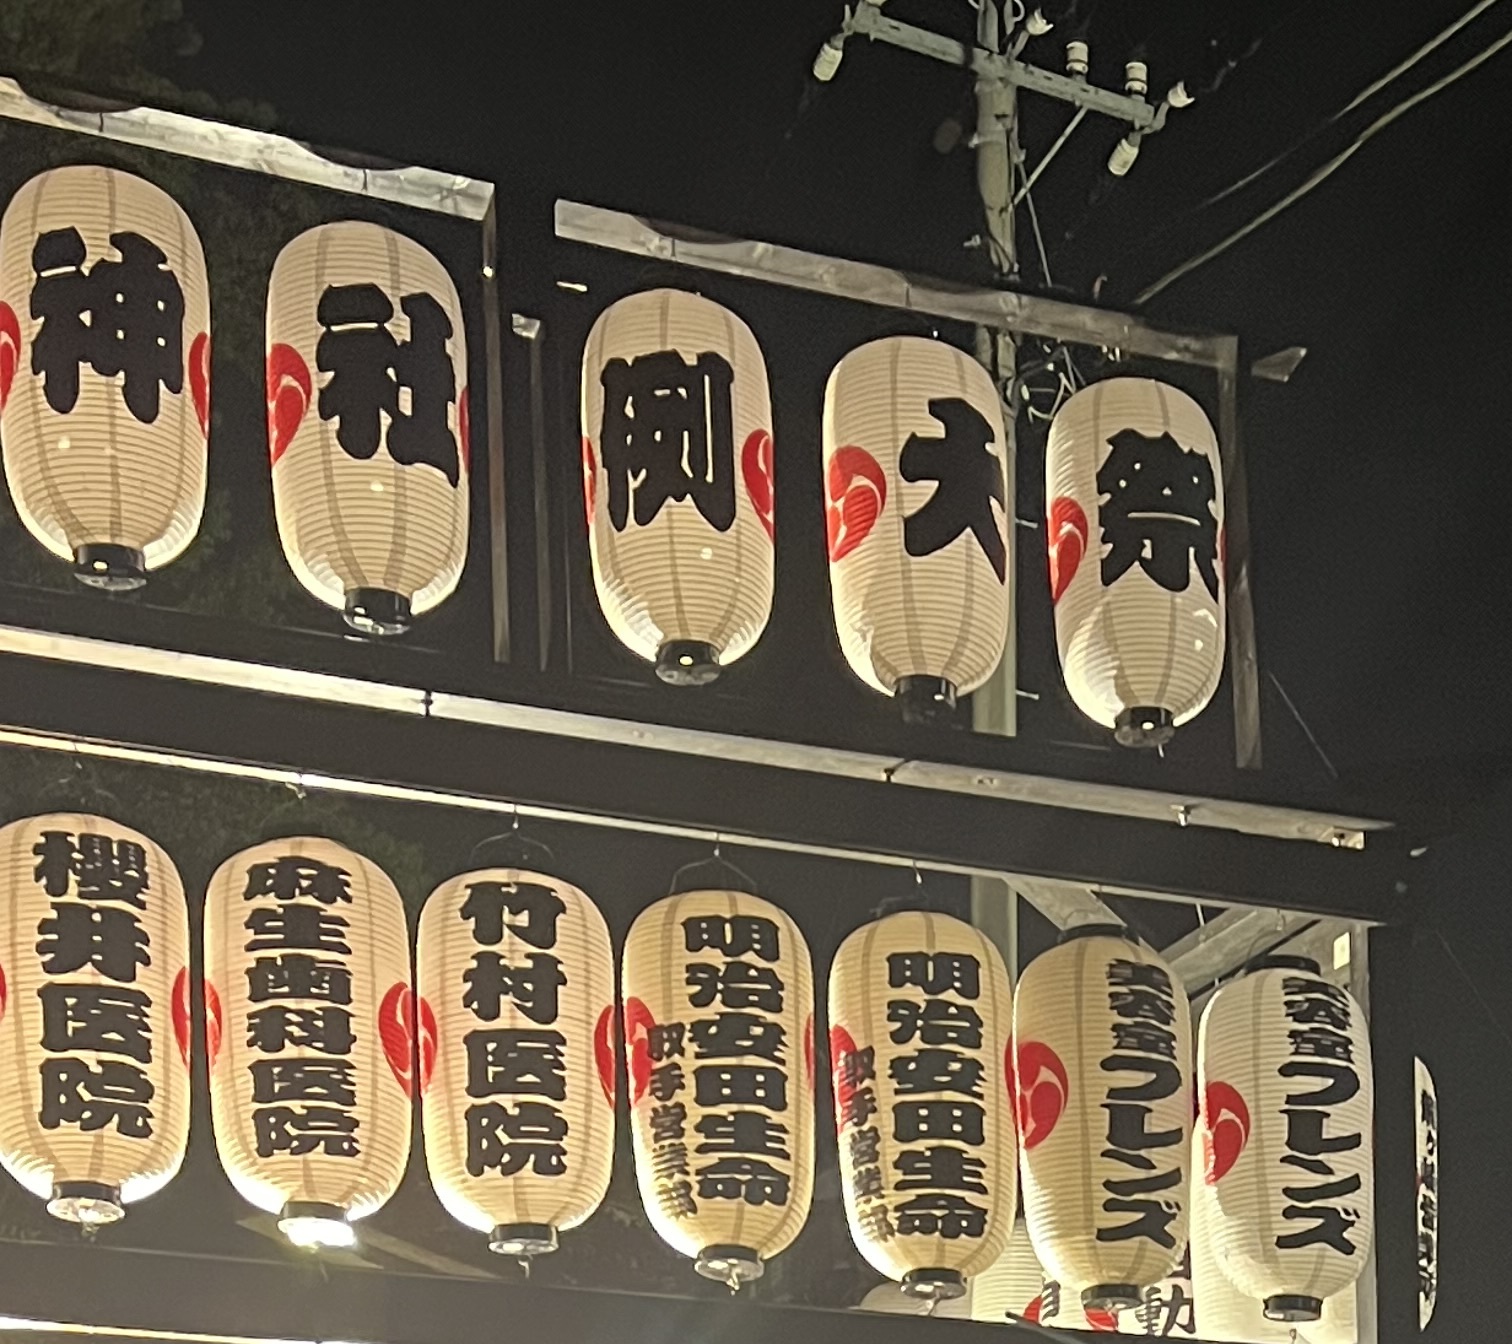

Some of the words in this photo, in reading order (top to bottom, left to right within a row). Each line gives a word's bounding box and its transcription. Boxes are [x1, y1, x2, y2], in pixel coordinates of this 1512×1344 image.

[30, 226, 185, 424] 神
[316, 284, 459, 488] 社
[900, 398, 1008, 586] 大
[1097, 428, 1220, 605] 祭
[33, 831, 154, 1138] 櫻井医院
[243, 856, 361, 1159] 麻生歯科医院
[460, 881, 568, 1177] 竹村医院
[682, 915, 791, 1206] 明治安田生命
[886, 952, 988, 1240] 明治安田生命
[1096, 958, 1184, 1250] 美容室フレンズ
[1275, 977, 1361, 1256] 美容室フレンズ
